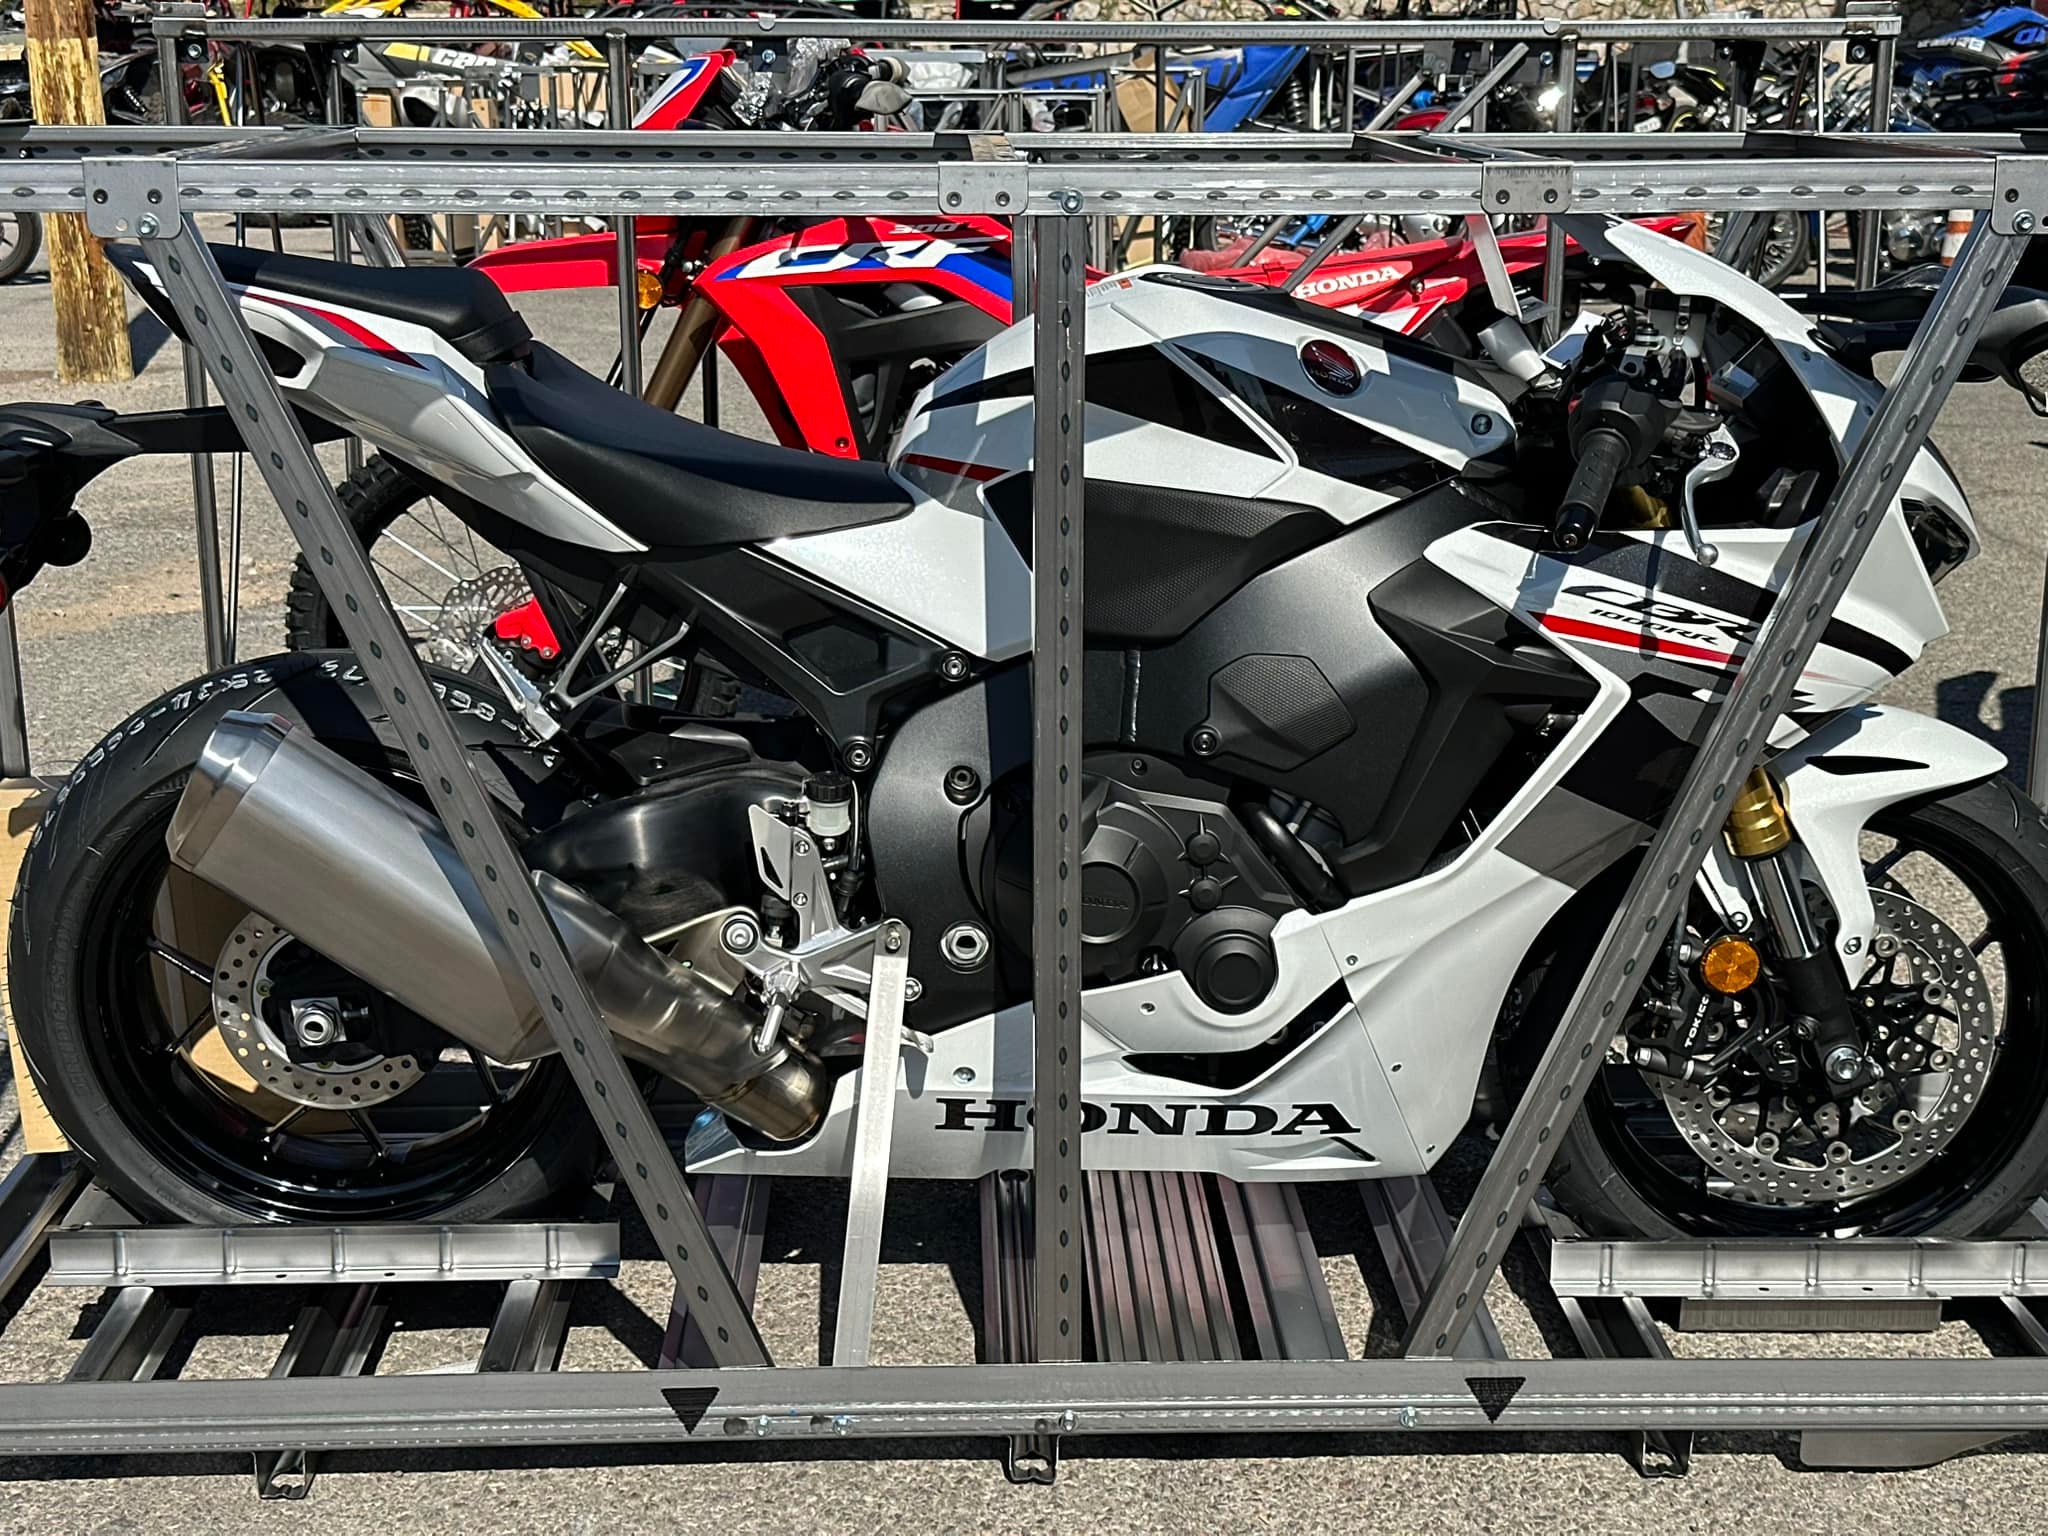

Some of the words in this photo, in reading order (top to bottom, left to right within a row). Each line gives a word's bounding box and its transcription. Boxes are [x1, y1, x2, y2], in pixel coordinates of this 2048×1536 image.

[736, 237, 1009, 279] CRF
[1293, 266, 1402, 299] HONDA
[1561, 585, 1757, 644] CBR
[1589, 609, 1718, 646] 1000RR
